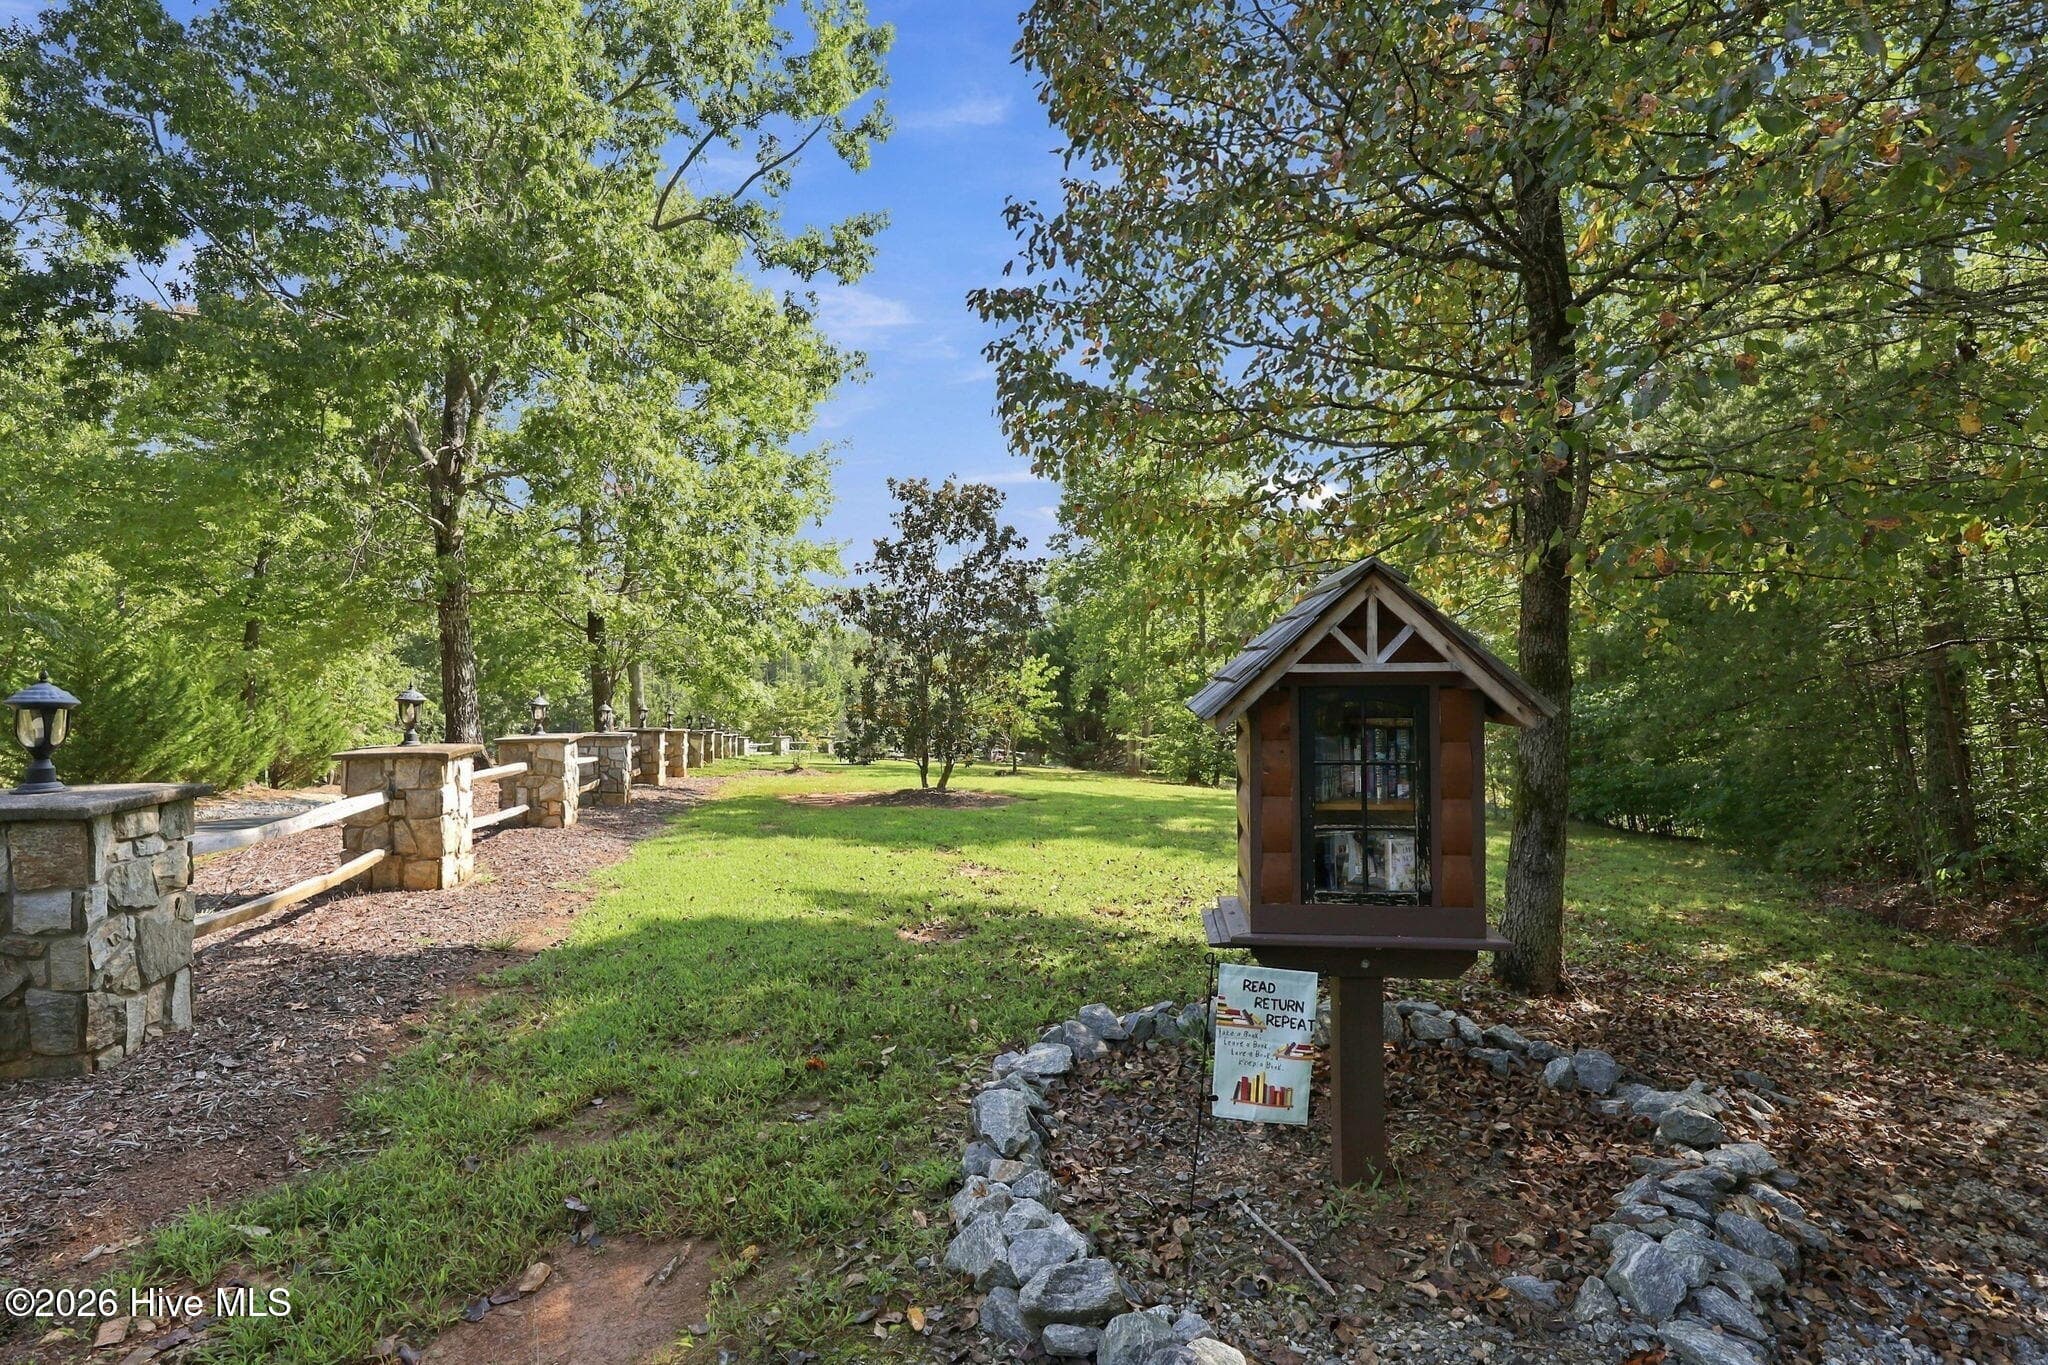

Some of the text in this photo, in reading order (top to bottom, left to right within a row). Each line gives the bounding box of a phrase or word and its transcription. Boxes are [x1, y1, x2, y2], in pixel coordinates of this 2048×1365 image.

[1243, 979, 1276, 994] READ
[1254, 996, 1305, 1014] RETURN
[1266, 1013, 1316, 1032] REPEAT
[1218, 1028, 1235, 1038] Take
[1223, 1039, 1244, 1047] Leave
[1231, 1048, 1247, 1057] Love
